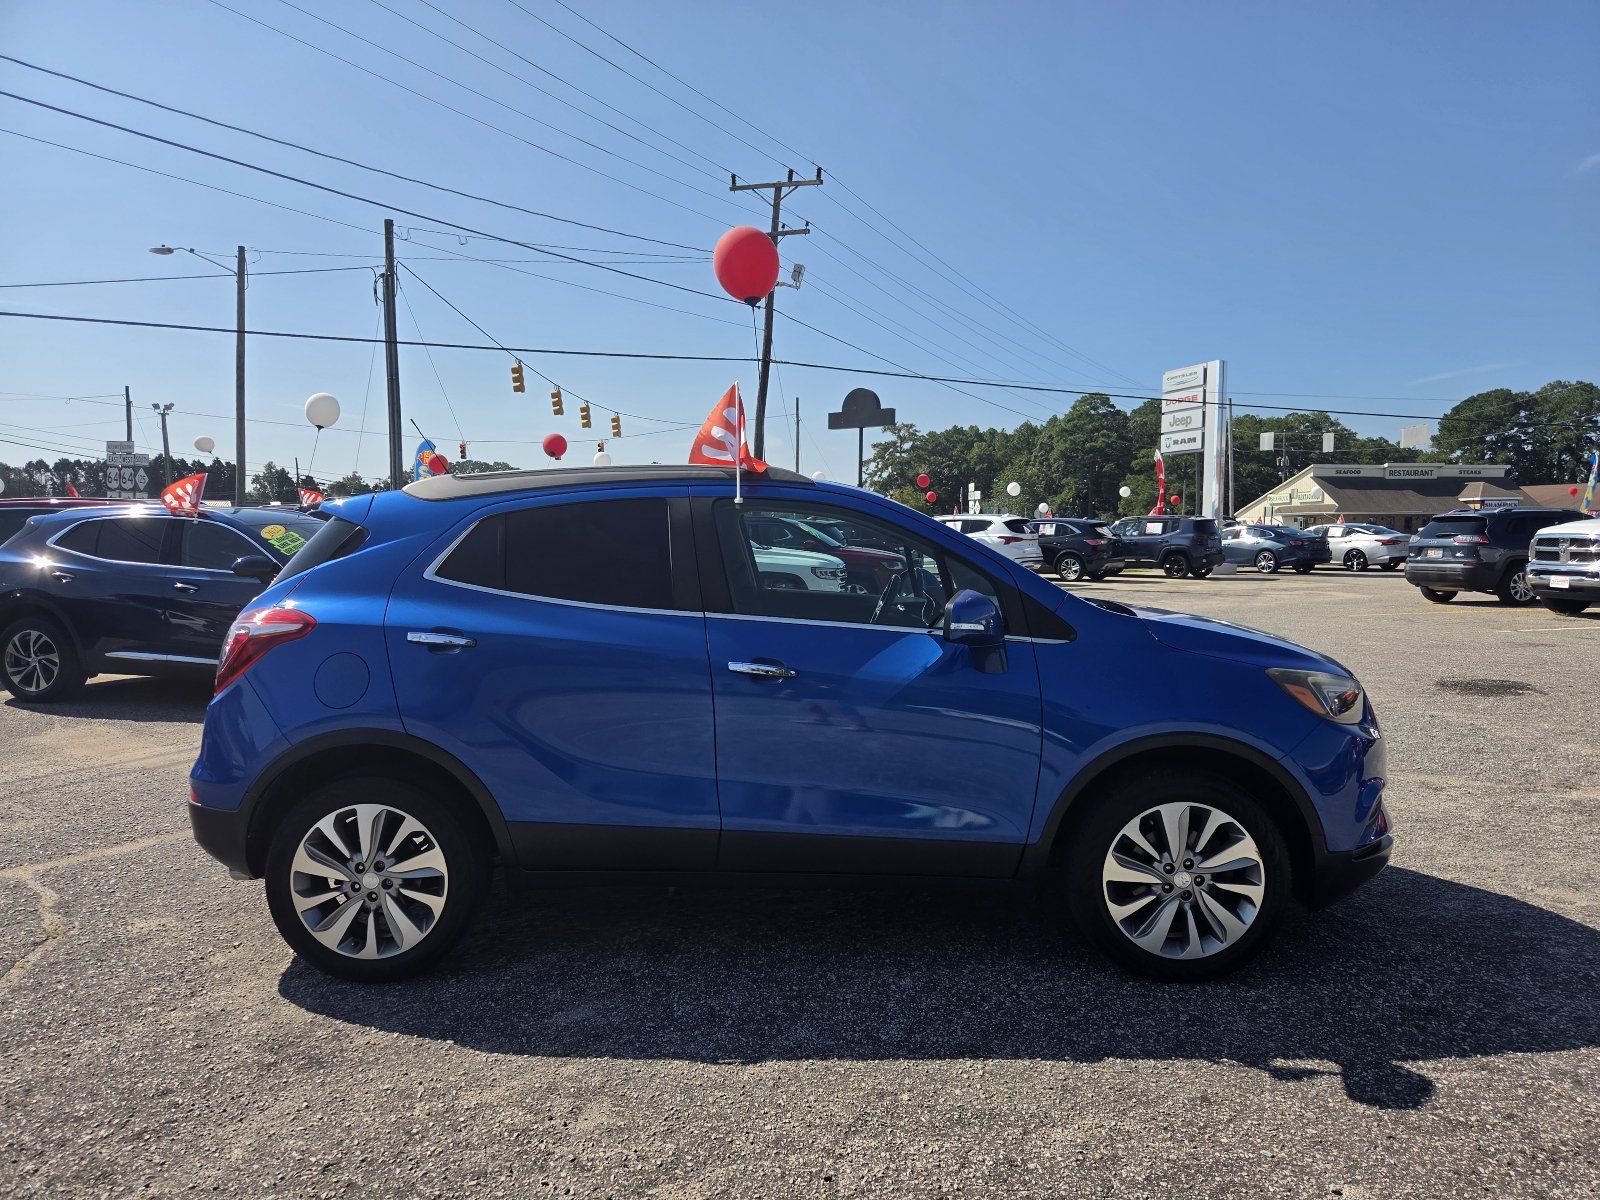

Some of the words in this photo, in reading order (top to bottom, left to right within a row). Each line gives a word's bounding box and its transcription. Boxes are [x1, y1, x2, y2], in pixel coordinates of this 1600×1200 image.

[1165, 394, 1198, 406] DODGE
[1169, 414, 1192, 427] Jeep
[1172, 436, 1197, 446] RAM
[108, 455, 119, 463] EAST
[121, 456, 133, 464] WEST
[107, 471, 118, 484] 64
[121, 471, 133, 484] 64
[1388, 469, 1434, 477] RESTAURANT
